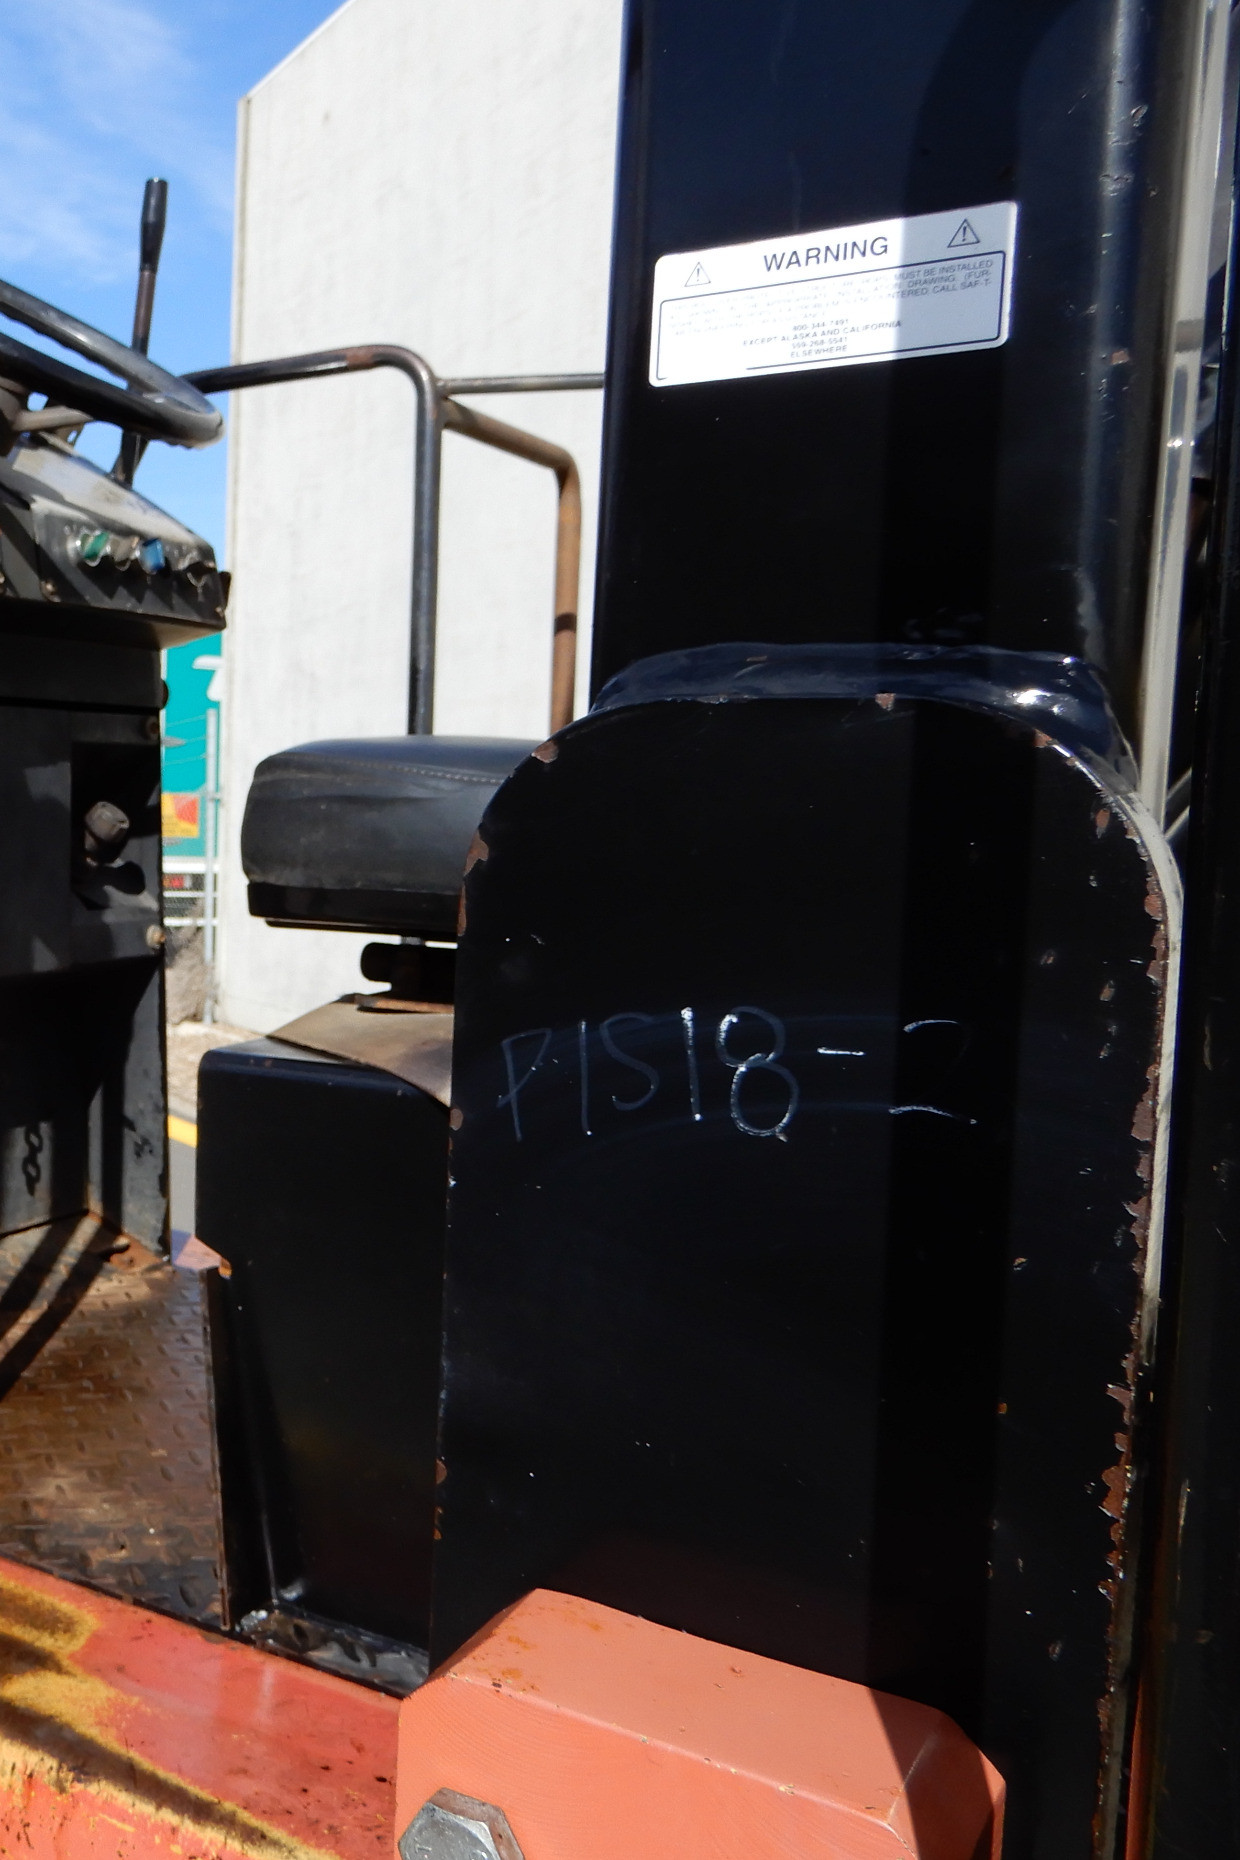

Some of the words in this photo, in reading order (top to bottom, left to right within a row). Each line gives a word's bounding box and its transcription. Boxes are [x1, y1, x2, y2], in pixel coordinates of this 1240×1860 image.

[763, 235, 889, 273] WARNING
[923, 268, 937, 277] BE
[939, 260, 993, 274] INSTALLED
[932, 284, 959, 294] CALL
[743, 336, 777, 346] EXCEPT
[781, 331, 818, 341] ALASKA
[820, 328, 840, 337] AND
[843, 320, 902, 334] CALIFORNIA
[791, 345, 848, 358] ELSEWHERE
